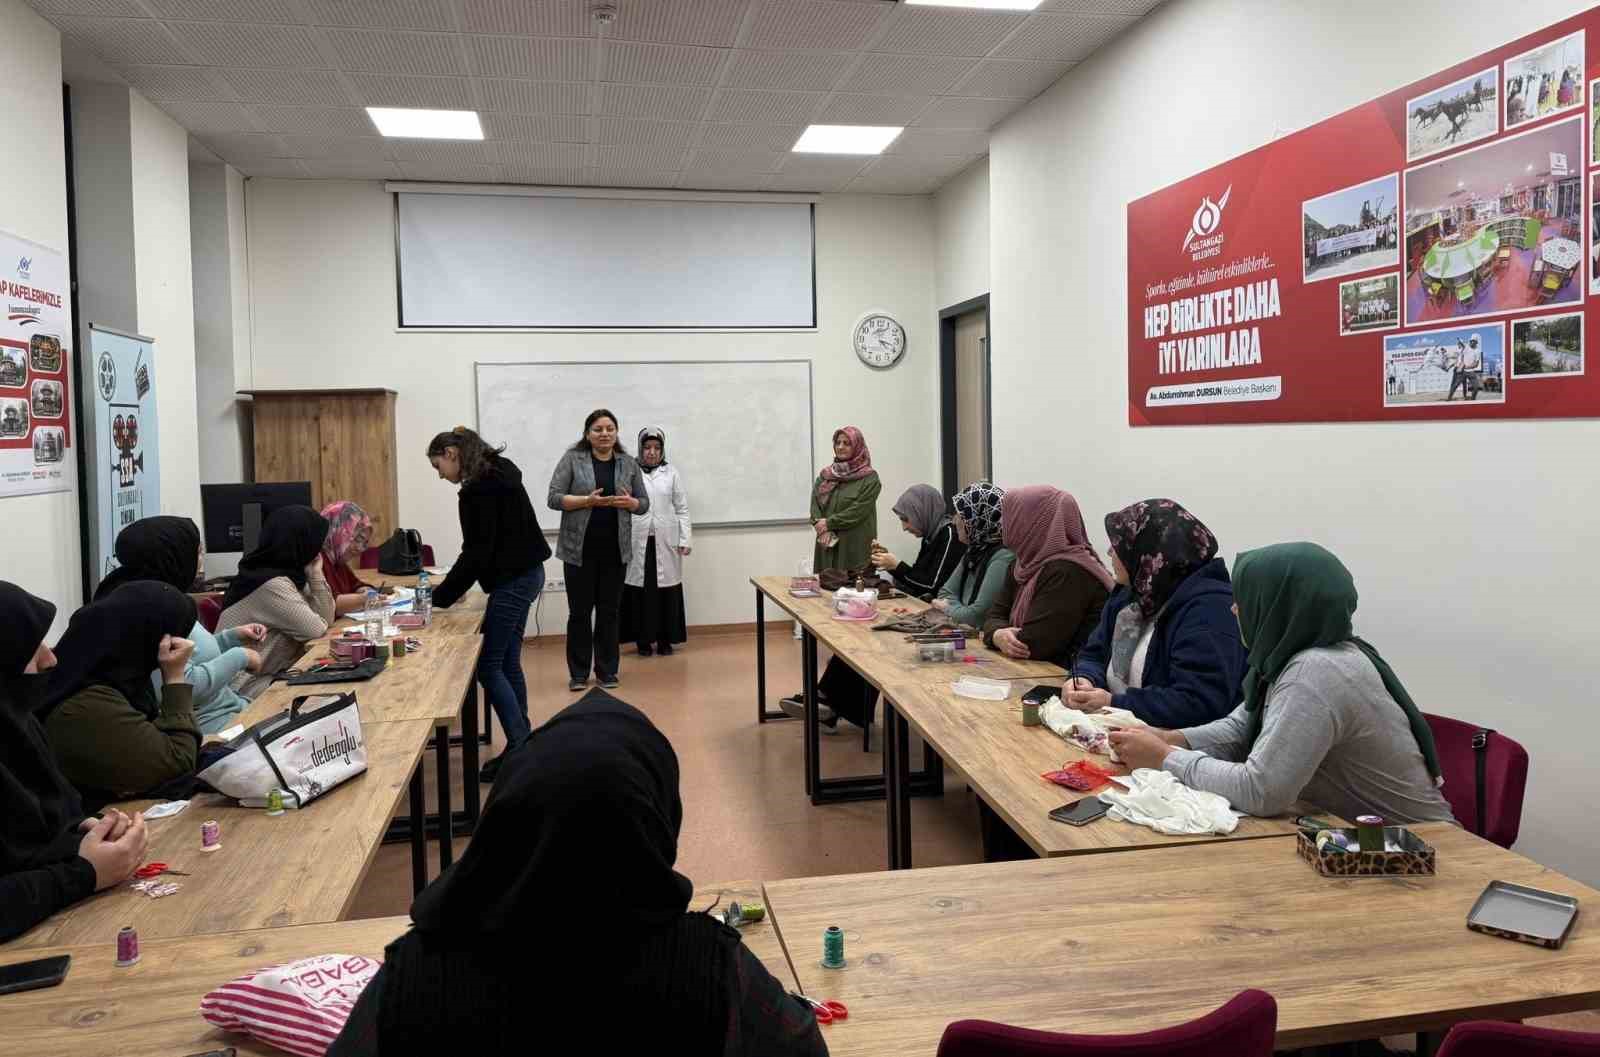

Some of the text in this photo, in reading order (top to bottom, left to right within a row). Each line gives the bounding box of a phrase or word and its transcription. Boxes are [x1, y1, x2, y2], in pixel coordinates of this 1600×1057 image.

[1145, 278, 1281, 339] HEP BİRLİKTE DAHA
[1159, 327, 1262, 374] İYİ YARINLARA
[1196, 386, 1222, 397] DURSUN
